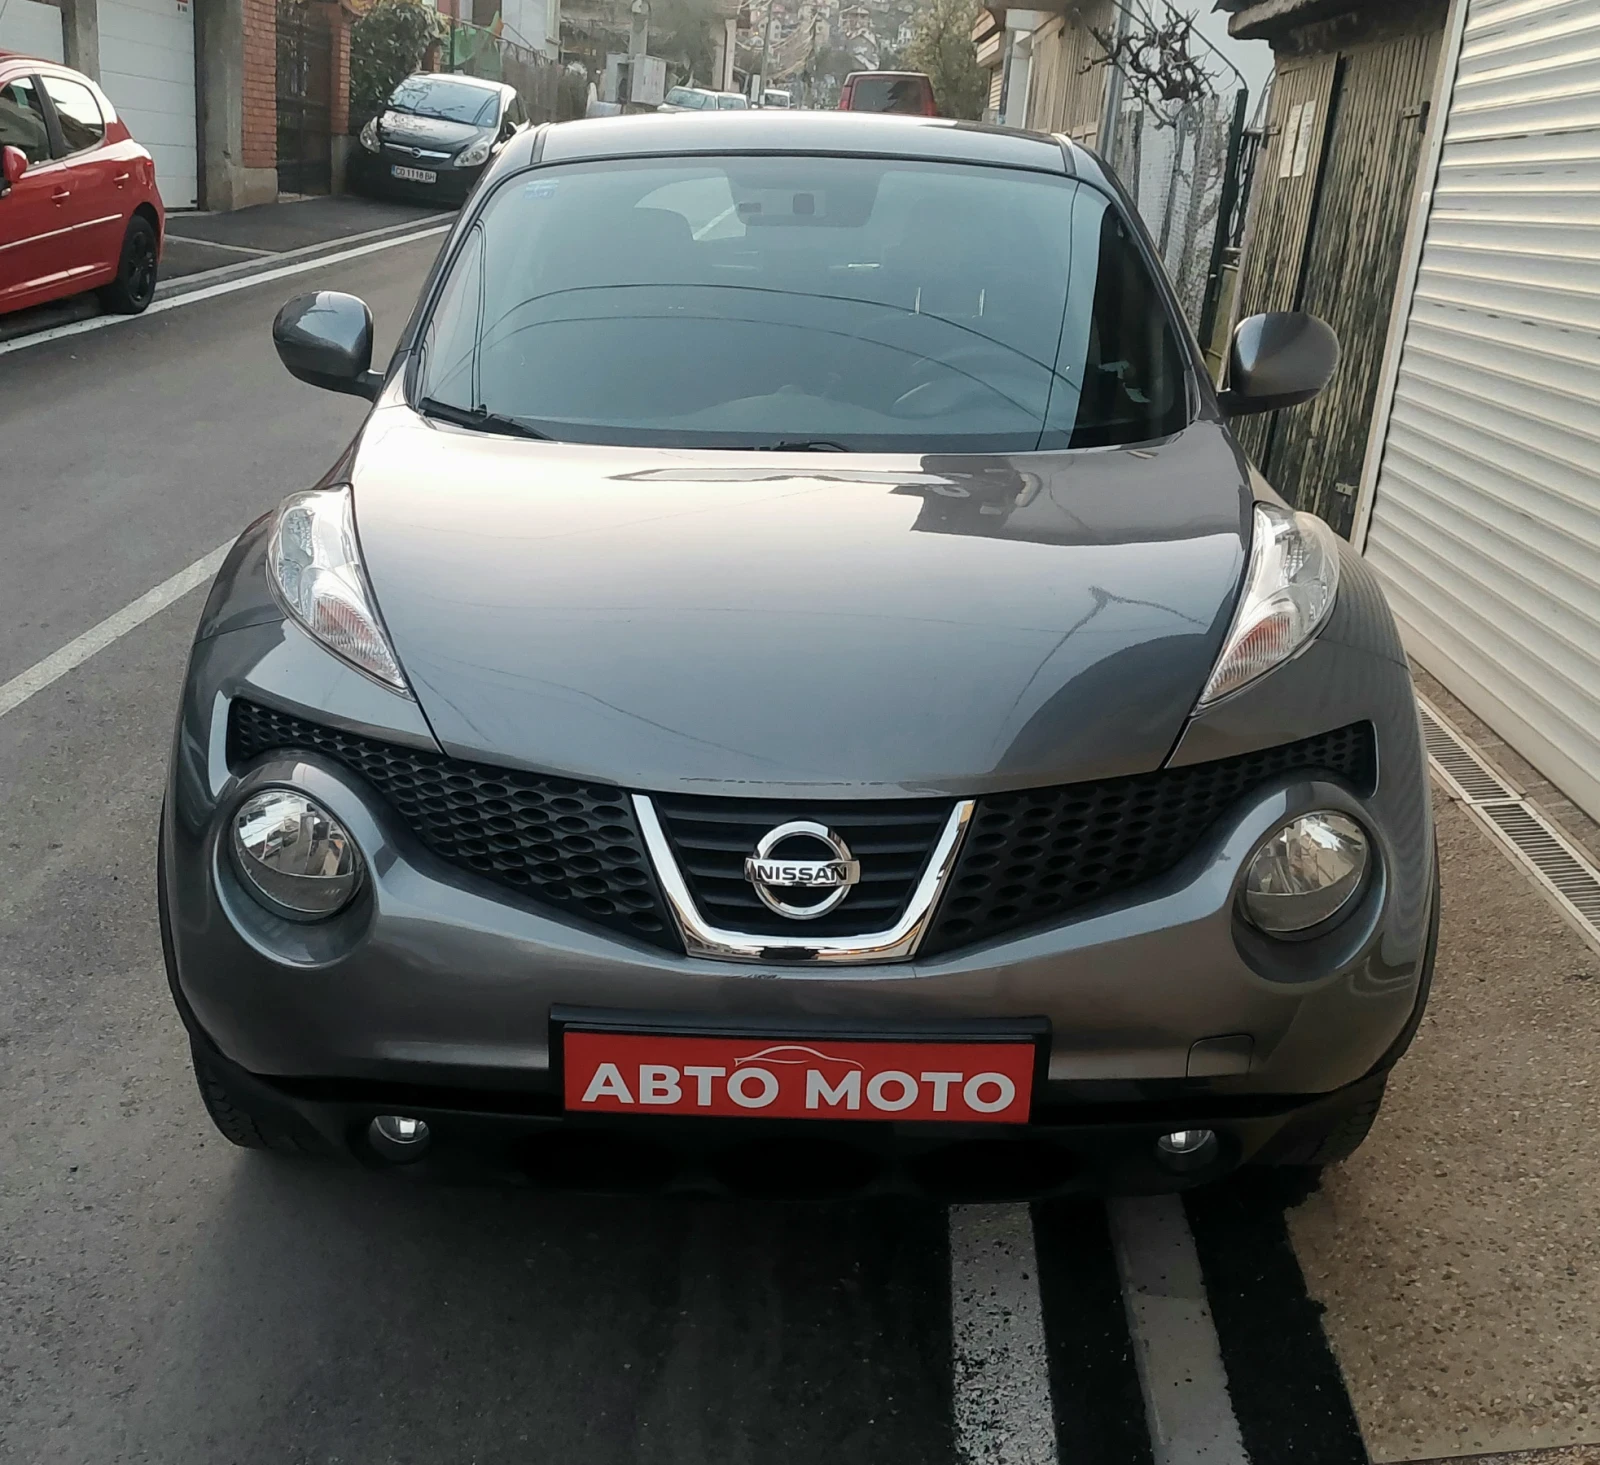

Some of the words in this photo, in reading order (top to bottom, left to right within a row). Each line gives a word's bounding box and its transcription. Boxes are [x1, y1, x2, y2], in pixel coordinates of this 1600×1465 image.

[407, 169, 424, 179] 1118
[757, 865, 847, 881] NISSAN
[581, 1062, 779, 1108] АВТО
[805, 1069, 1016, 1113] МОТО
